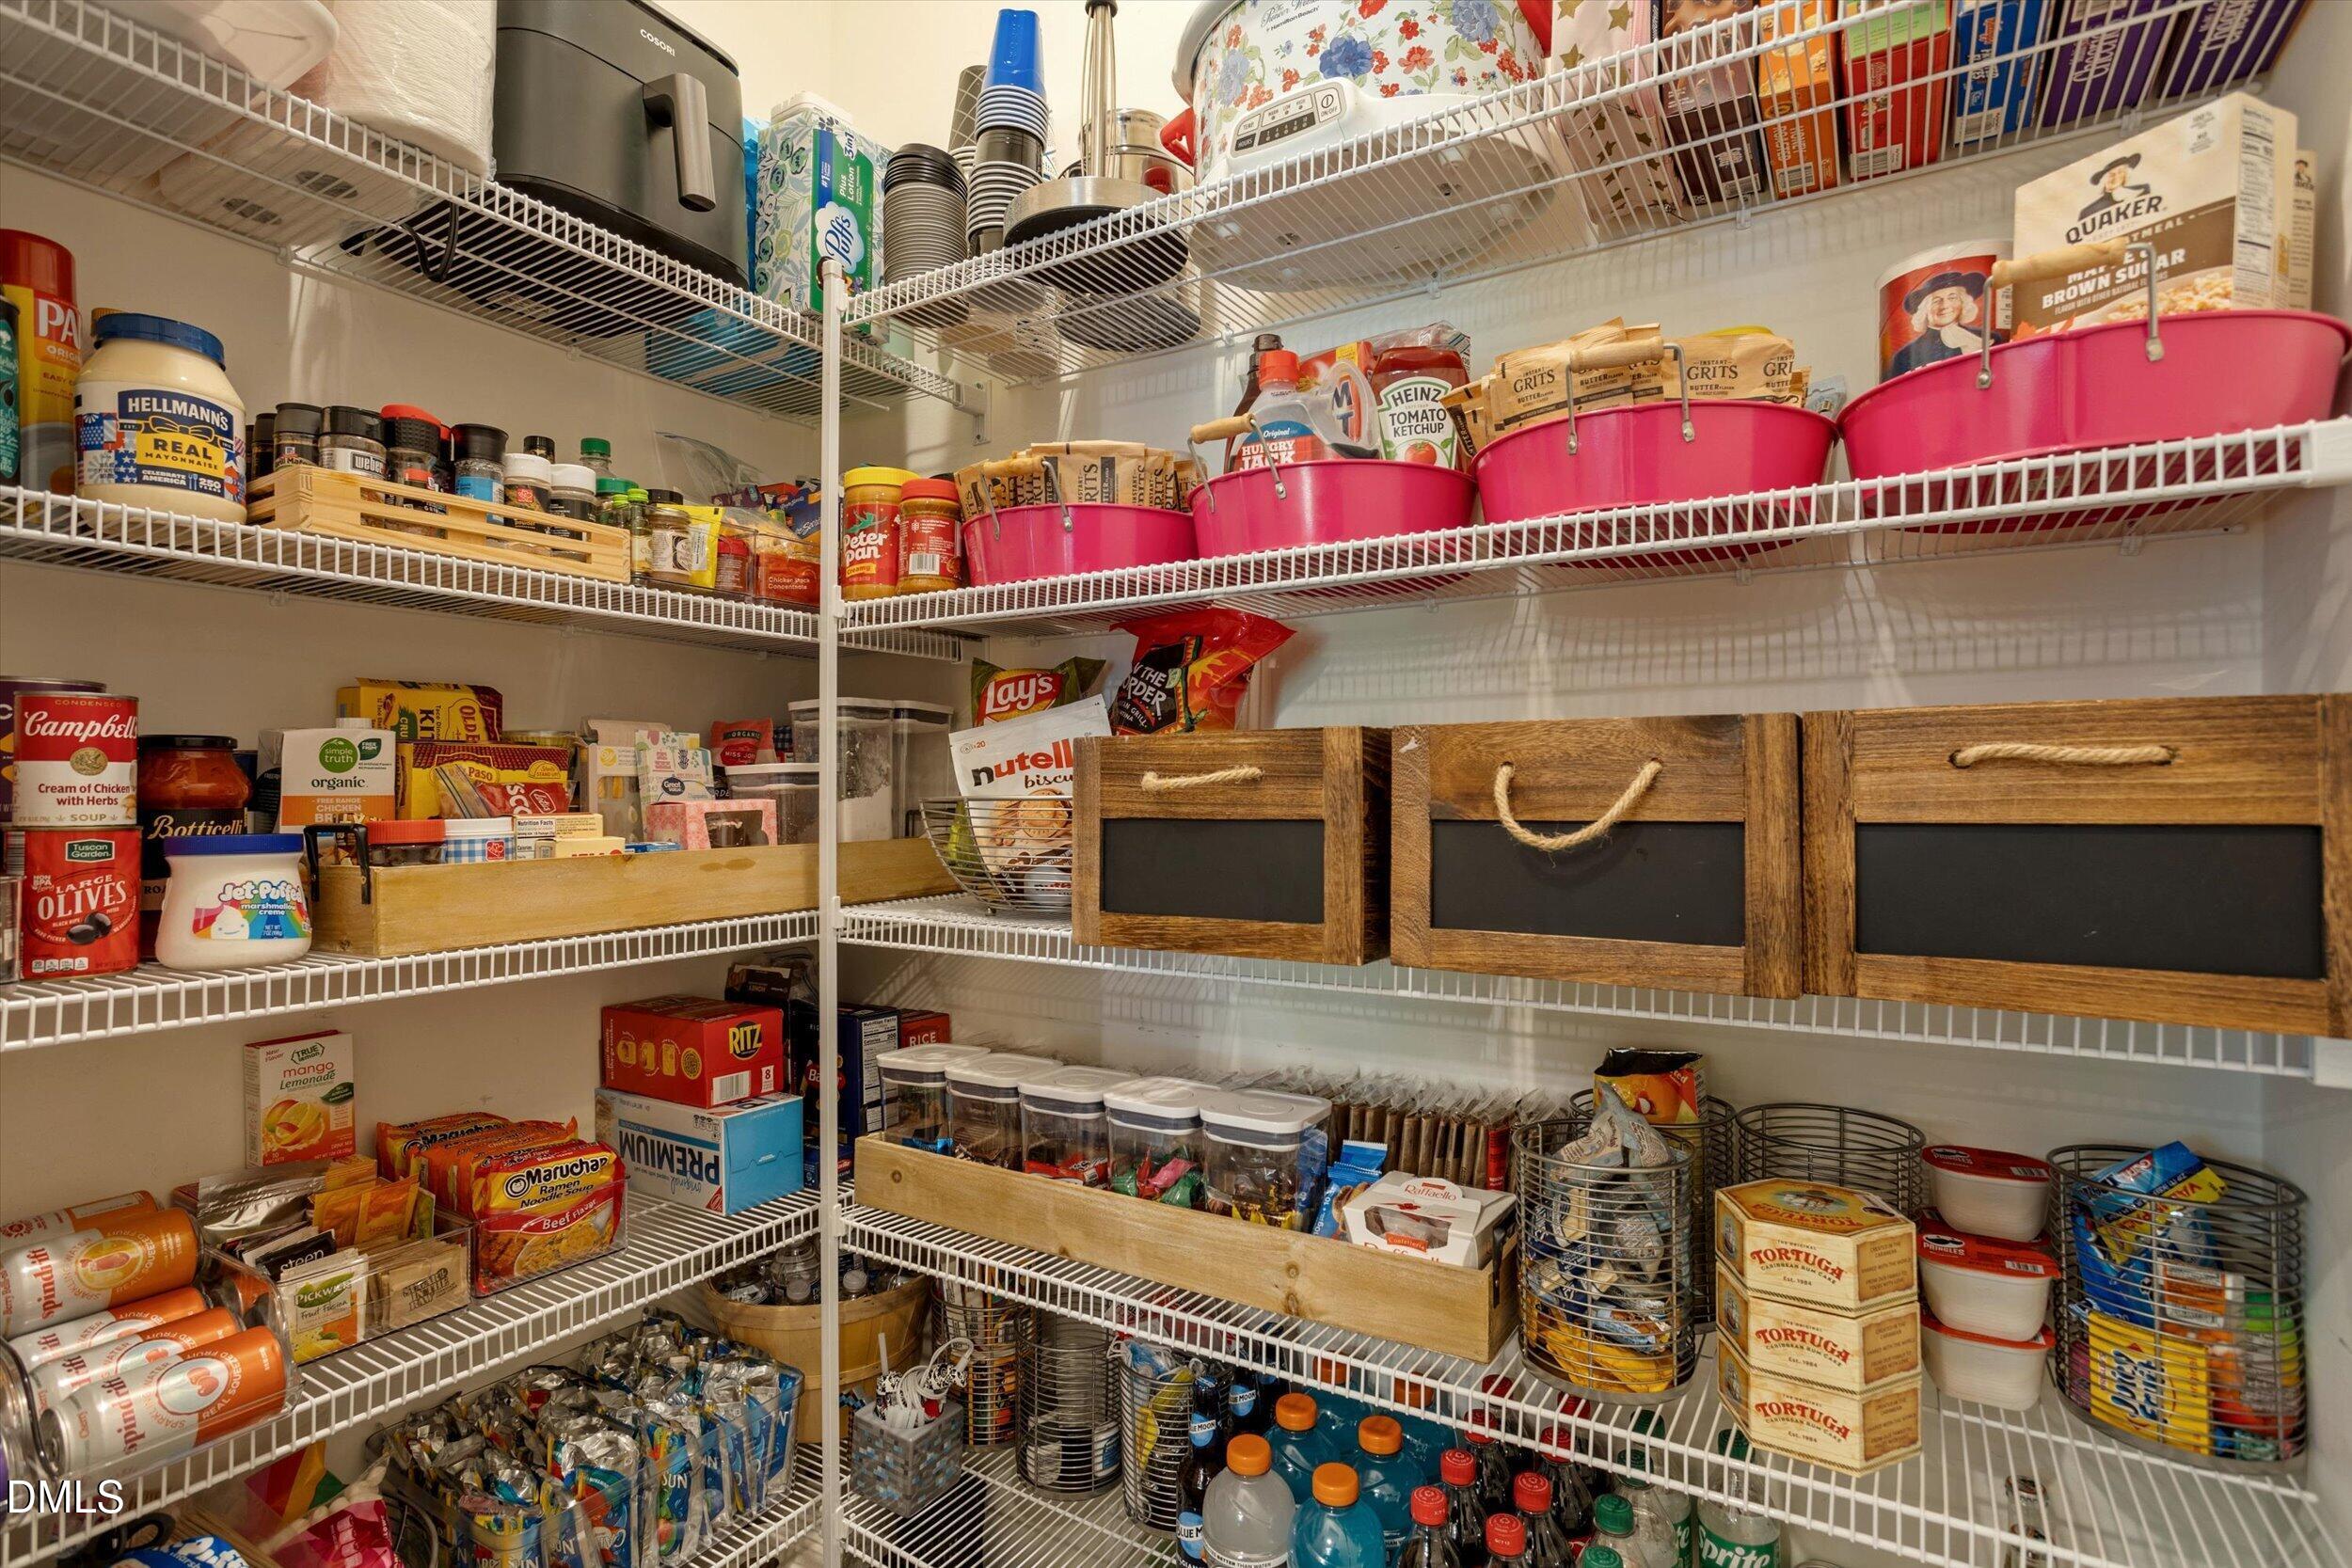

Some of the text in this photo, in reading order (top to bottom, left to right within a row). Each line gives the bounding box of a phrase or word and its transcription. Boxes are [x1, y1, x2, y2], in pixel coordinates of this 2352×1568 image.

[640, 28, 675, 57] COSORI
[1320, 105, 1339, 117] ON/OFF
[847, 166, 855, 201] Lotion
[2065, 195, 2163, 245] QUAKER
[824, 215, 854, 267] Puffs
[2042, 272, 2111, 309] BROWN
[38, 297, 82, 349] PA
[1687, 365, 1740, 381] GRITS
[1763, 361, 1793, 378] GRI
[1513, 369, 1556, 393] GRITS
[1580, 372, 1607, 387] BUTTER
[1392, 386, 1442, 406] HEINZ
[1518, 392, 1540, 404] BUTTER
[128, 396, 229, 432] HELLMANN'S
[1390, 408, 1447, 427] TOMATO
[1263, 426, 1291, 438] Original
[1393, 422, 1445, 438] KETCHUP
[153, 437, 213, 461] REAL
[144, 451, 219, 470] MAYONNAISE
[355, 455, 385, 474] weber
[142, 468, 186, 481] CELEBRATE
[142, 475, 187, 487] AMERICA
[199, 478, 223, 490] 250
[1084, 463, 1099, 503] RITS
[843, 531, 889, 549] Peter
[847, 565, 871, 575] Creamy
[1140, 666, 1168, 688] THE
[984, 672, 1056, 715] Lay's
[1122, 675, 1168, 717] ORDER
[55, 699, 122, 708] CONDENSED
[459, 705, 477, 733] OLD
[731, 730, 762, 739] ORGANIC
[325, 747, 354, 755] simple
[325, 754, 354, 764] truth
[971, 738, 1073, 787] nutell
[468, 767, 493, 782] Paso
[1024, 773, 1073, 790] biscu
[39, 783, 131, 794] Cream of Chicken
[56, 795, 119, 806] with Herbs
[316, 803, 362, 813] CHICKEN
[71, 814, 107, 822] SOUP
[147, 814, 244, 840] Botticelli
[72, 843, 109, 851] Tuscan
[56, 874, 114, 894] LARGE
[38, 879, 128, 921] OLIVES
[728, 1022, 763, 1054] RITZ
[909, 1031, 937, 1047] RICE
[295, 1045, 319, 1058] TRUE
[282, 1061, 335, 1078] mango
[765, 1069, 771, 1080] 8
[279, 1069, 337, 1090] Lemonade
[619, 1130, 721, 1185] PREMIUM
[1932, 1152, 1974, 1165] PRINGLES
[525, 1156, 610, 1186] Maruchan
[519, 1183, 595, 1209] Noodle Soup
[539, 1180, 580, 1196] Ramen
[1404, 1183, 1456, 1202] Raffaello
[542, 1199, 598, 1231] Beef Flavor
[1923, 1243, 1966, 1257] PRINGLES
[1750, 1247, 1846, 1281] TORTUGA
[1760, 1262, 1800, 1271] CARIBBEAN
[1801, 1264, 1817, 1275] RUM
[26, 1246, 63, 1320] spindrift
[294, 1279, 354, 1305] PICKWICK
[300, 1307, 320, 1320] Fruit
[1755, 1327, 1851, 1364] TORTUGA
[1238, 1390, 1256, 1402] MOON
[101, 1377, 146, 1456] spindrift
[201, 1396, 231, 1420] REAL
[1197, 1420, 1216, 1432] MOON
[1755, 1401, 1851, 1440] TORTUGA
[661, 1473, 688, 1489] SUN
[1697, 1526, 1771, 1568] Sprite
[1216, 1553, 1235, 1565] BETTER
